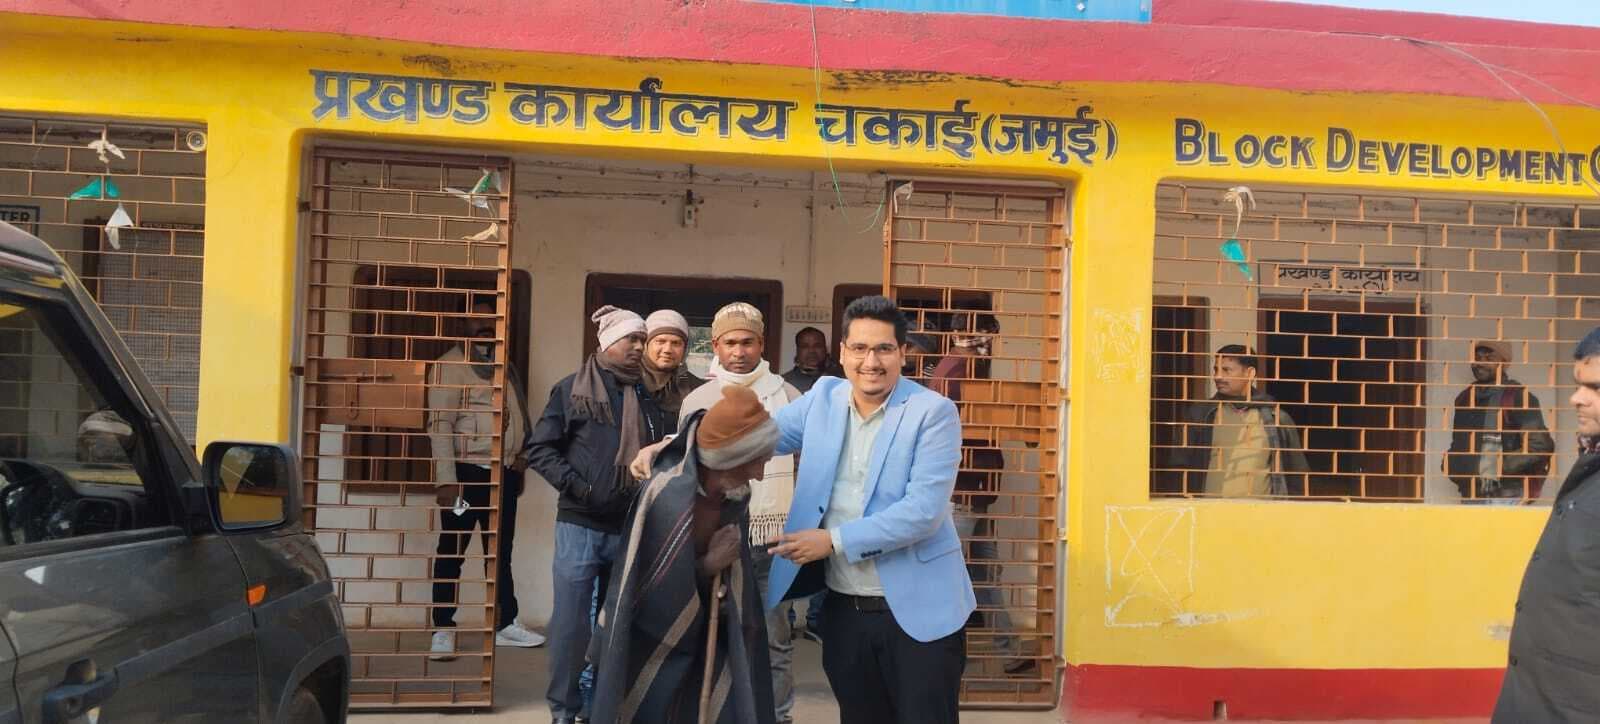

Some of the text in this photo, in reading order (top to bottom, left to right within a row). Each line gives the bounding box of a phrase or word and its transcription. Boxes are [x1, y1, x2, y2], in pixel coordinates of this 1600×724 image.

[308, 69, 496, 124] प्रखण्ड
[504, 76, 797, 141] कार्यालय
[1174, 117, 1317, 168] BLOCK
[1326, 127, 1587, 185] DEVELOPMENT
